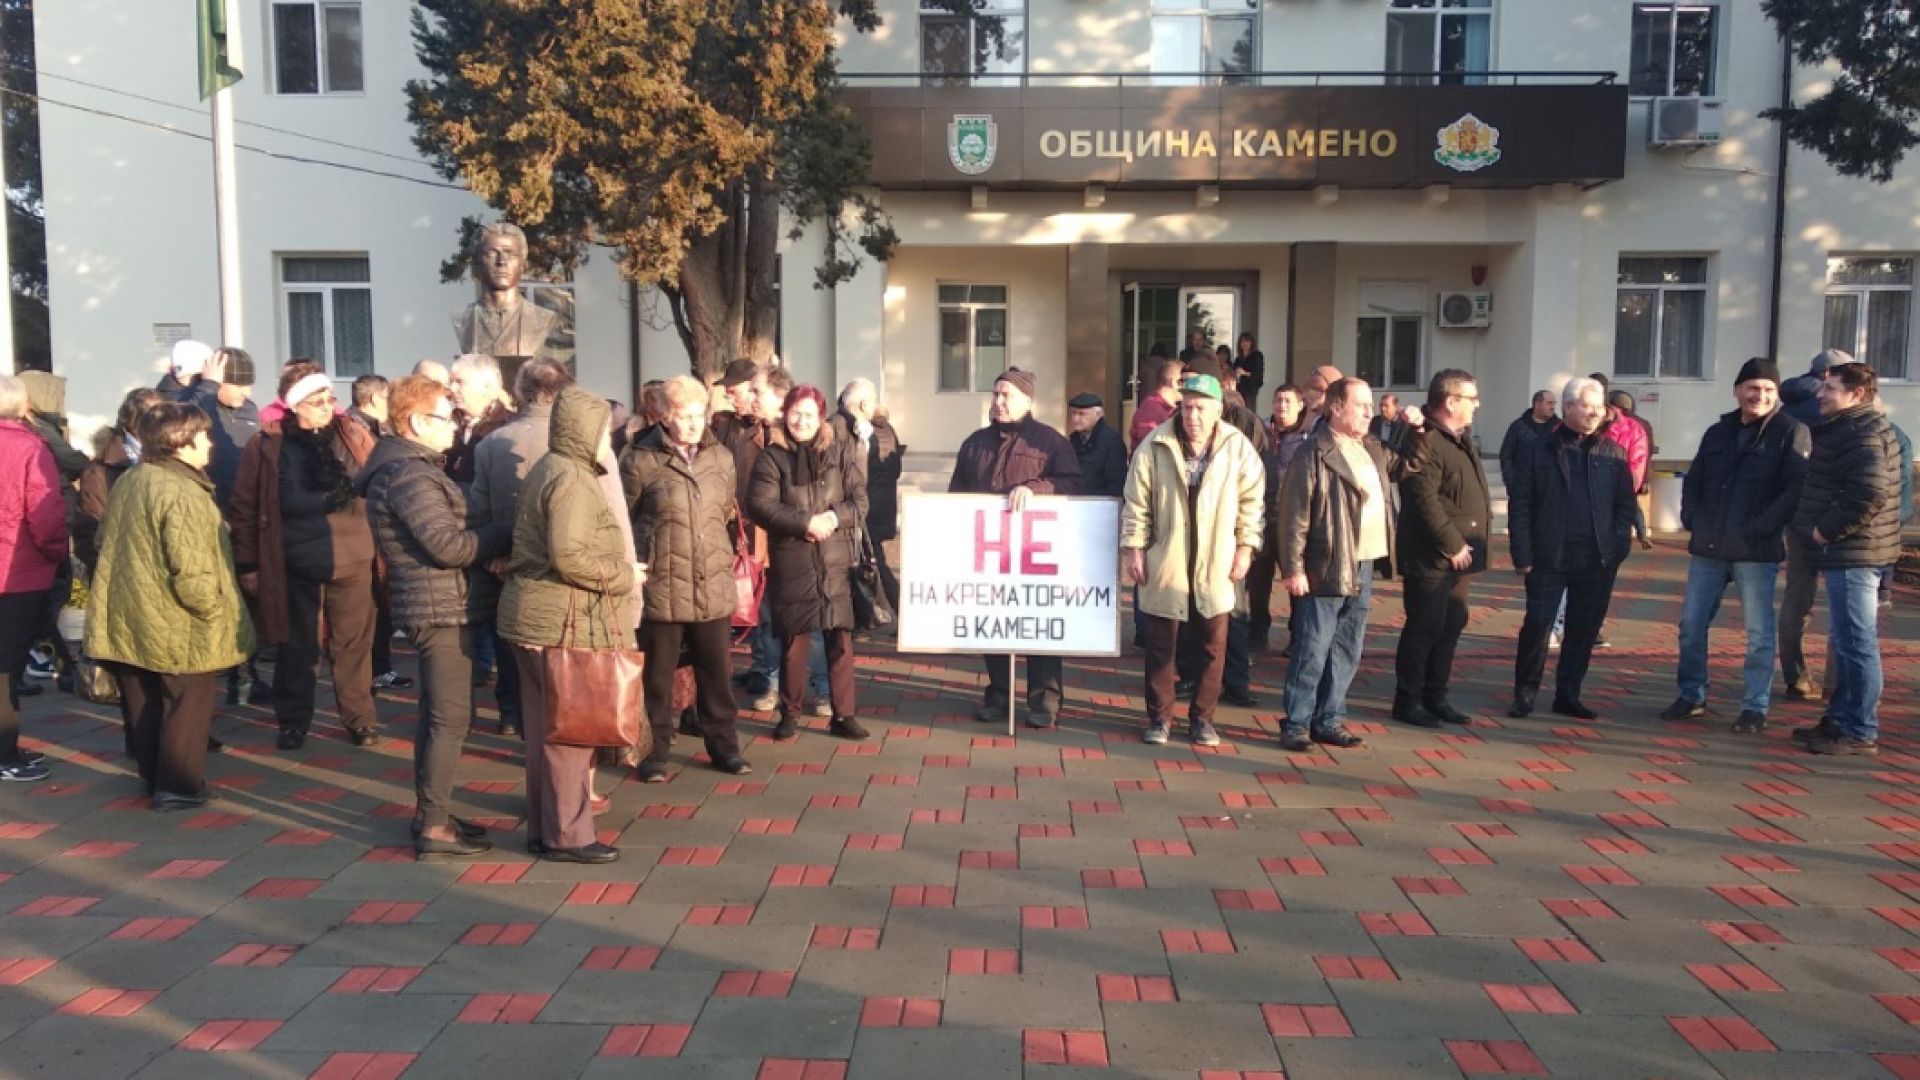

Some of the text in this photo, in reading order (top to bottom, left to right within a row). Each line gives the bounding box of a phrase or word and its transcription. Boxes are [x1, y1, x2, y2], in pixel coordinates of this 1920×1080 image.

[1039, 129, 1398, 161] ОБЩИНА КАМЕНО
[973, 510, 1059, 575] НЕ
[909, 582, 1110, 607] НА КРЕМАТОРИУМ
[953, 616, 1065, 641] В КАМЕНО
